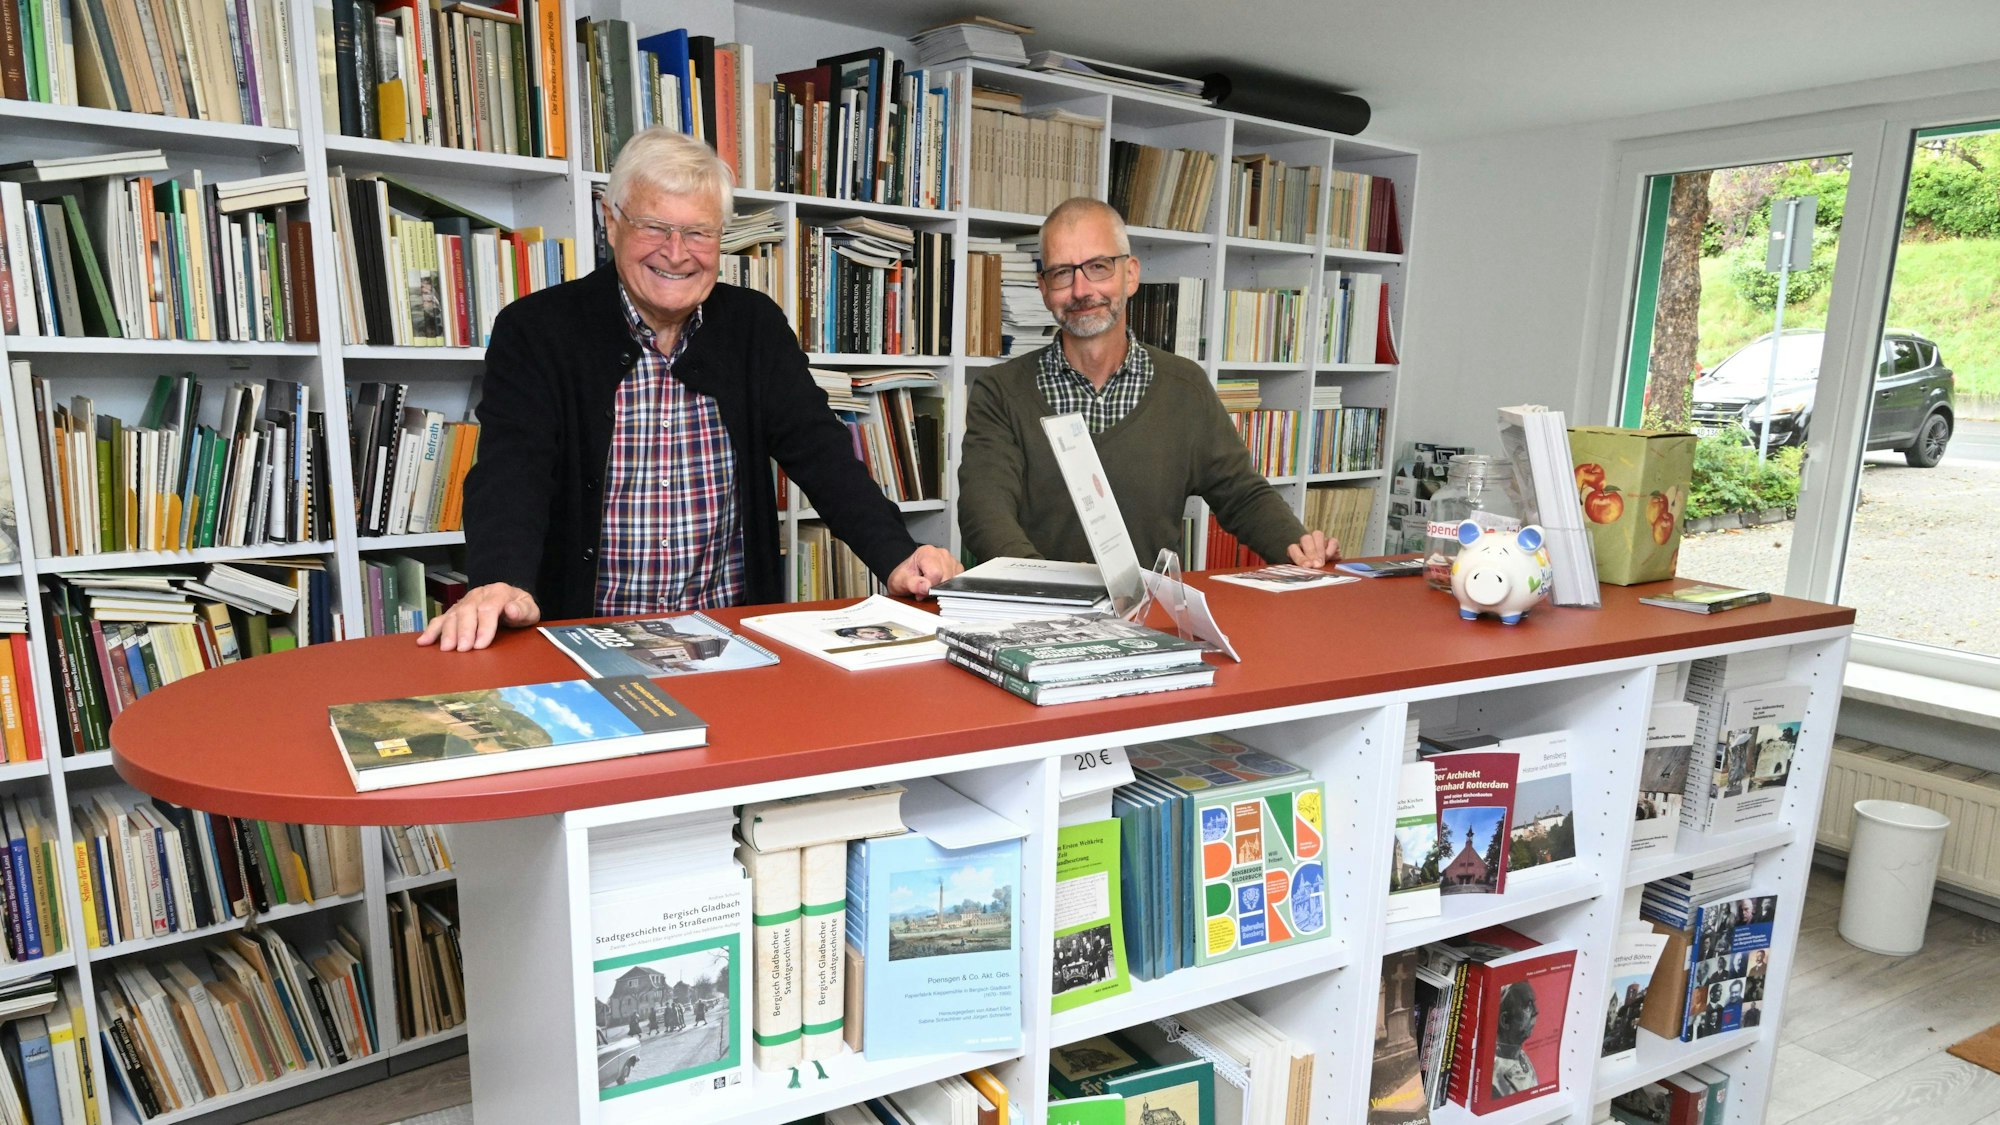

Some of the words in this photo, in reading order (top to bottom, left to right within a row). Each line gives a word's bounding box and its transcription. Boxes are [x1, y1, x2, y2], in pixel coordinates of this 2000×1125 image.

[547, 11, 555, 29] Kreis
[810, 265, 818, 293] Gladbach
[810, 293, 818, 319] Bergisch
[424, 423, 440, 461] Refrath
[592, 627, 634, 648] 2023
[0, 675, 11, 695] Wege
[4, 695, 16, 729] Bergische
[1074, 752, 1097, 771] 20
[1099, 748, 1112, 766] €
[1543, 752, 1567, 762] Bensberg
[1435, 781, 1465, 792] ernhard
[1466, 780, 1509, 790] Rotterdam
[1446, 770, 1480, 780] Architekt
[1079, 837, 1104, 848] Weltkrieg
[3, 854, 12, 869] Land
[79, 869, 88, 880] der
[1231, 872, 1263, 883] BILDERBUCH
[663, 907, 699, 921] Bergisch
[701, 899, 741, 913] Gladbach
[595, 925, 667, 945] Stadtgeschichte
[668, 922, 677, 931] in
[679, 911, 741, 929] Straßennamen
[771, 931, 780, 980] Gladbacher
[818, 920, 827, 969] Gladbacher
[830, 917, 839, 985] Stadtgeschichte
[783, 927, 794, 995] Stadtgeschichte
[1633, 953, 1652, 961] Böhm
[818, 970, 828, 1006] Bergisch
[927, 974, 961, 984] Poensgen
[773, 980, 783, 1017] Bergisch
